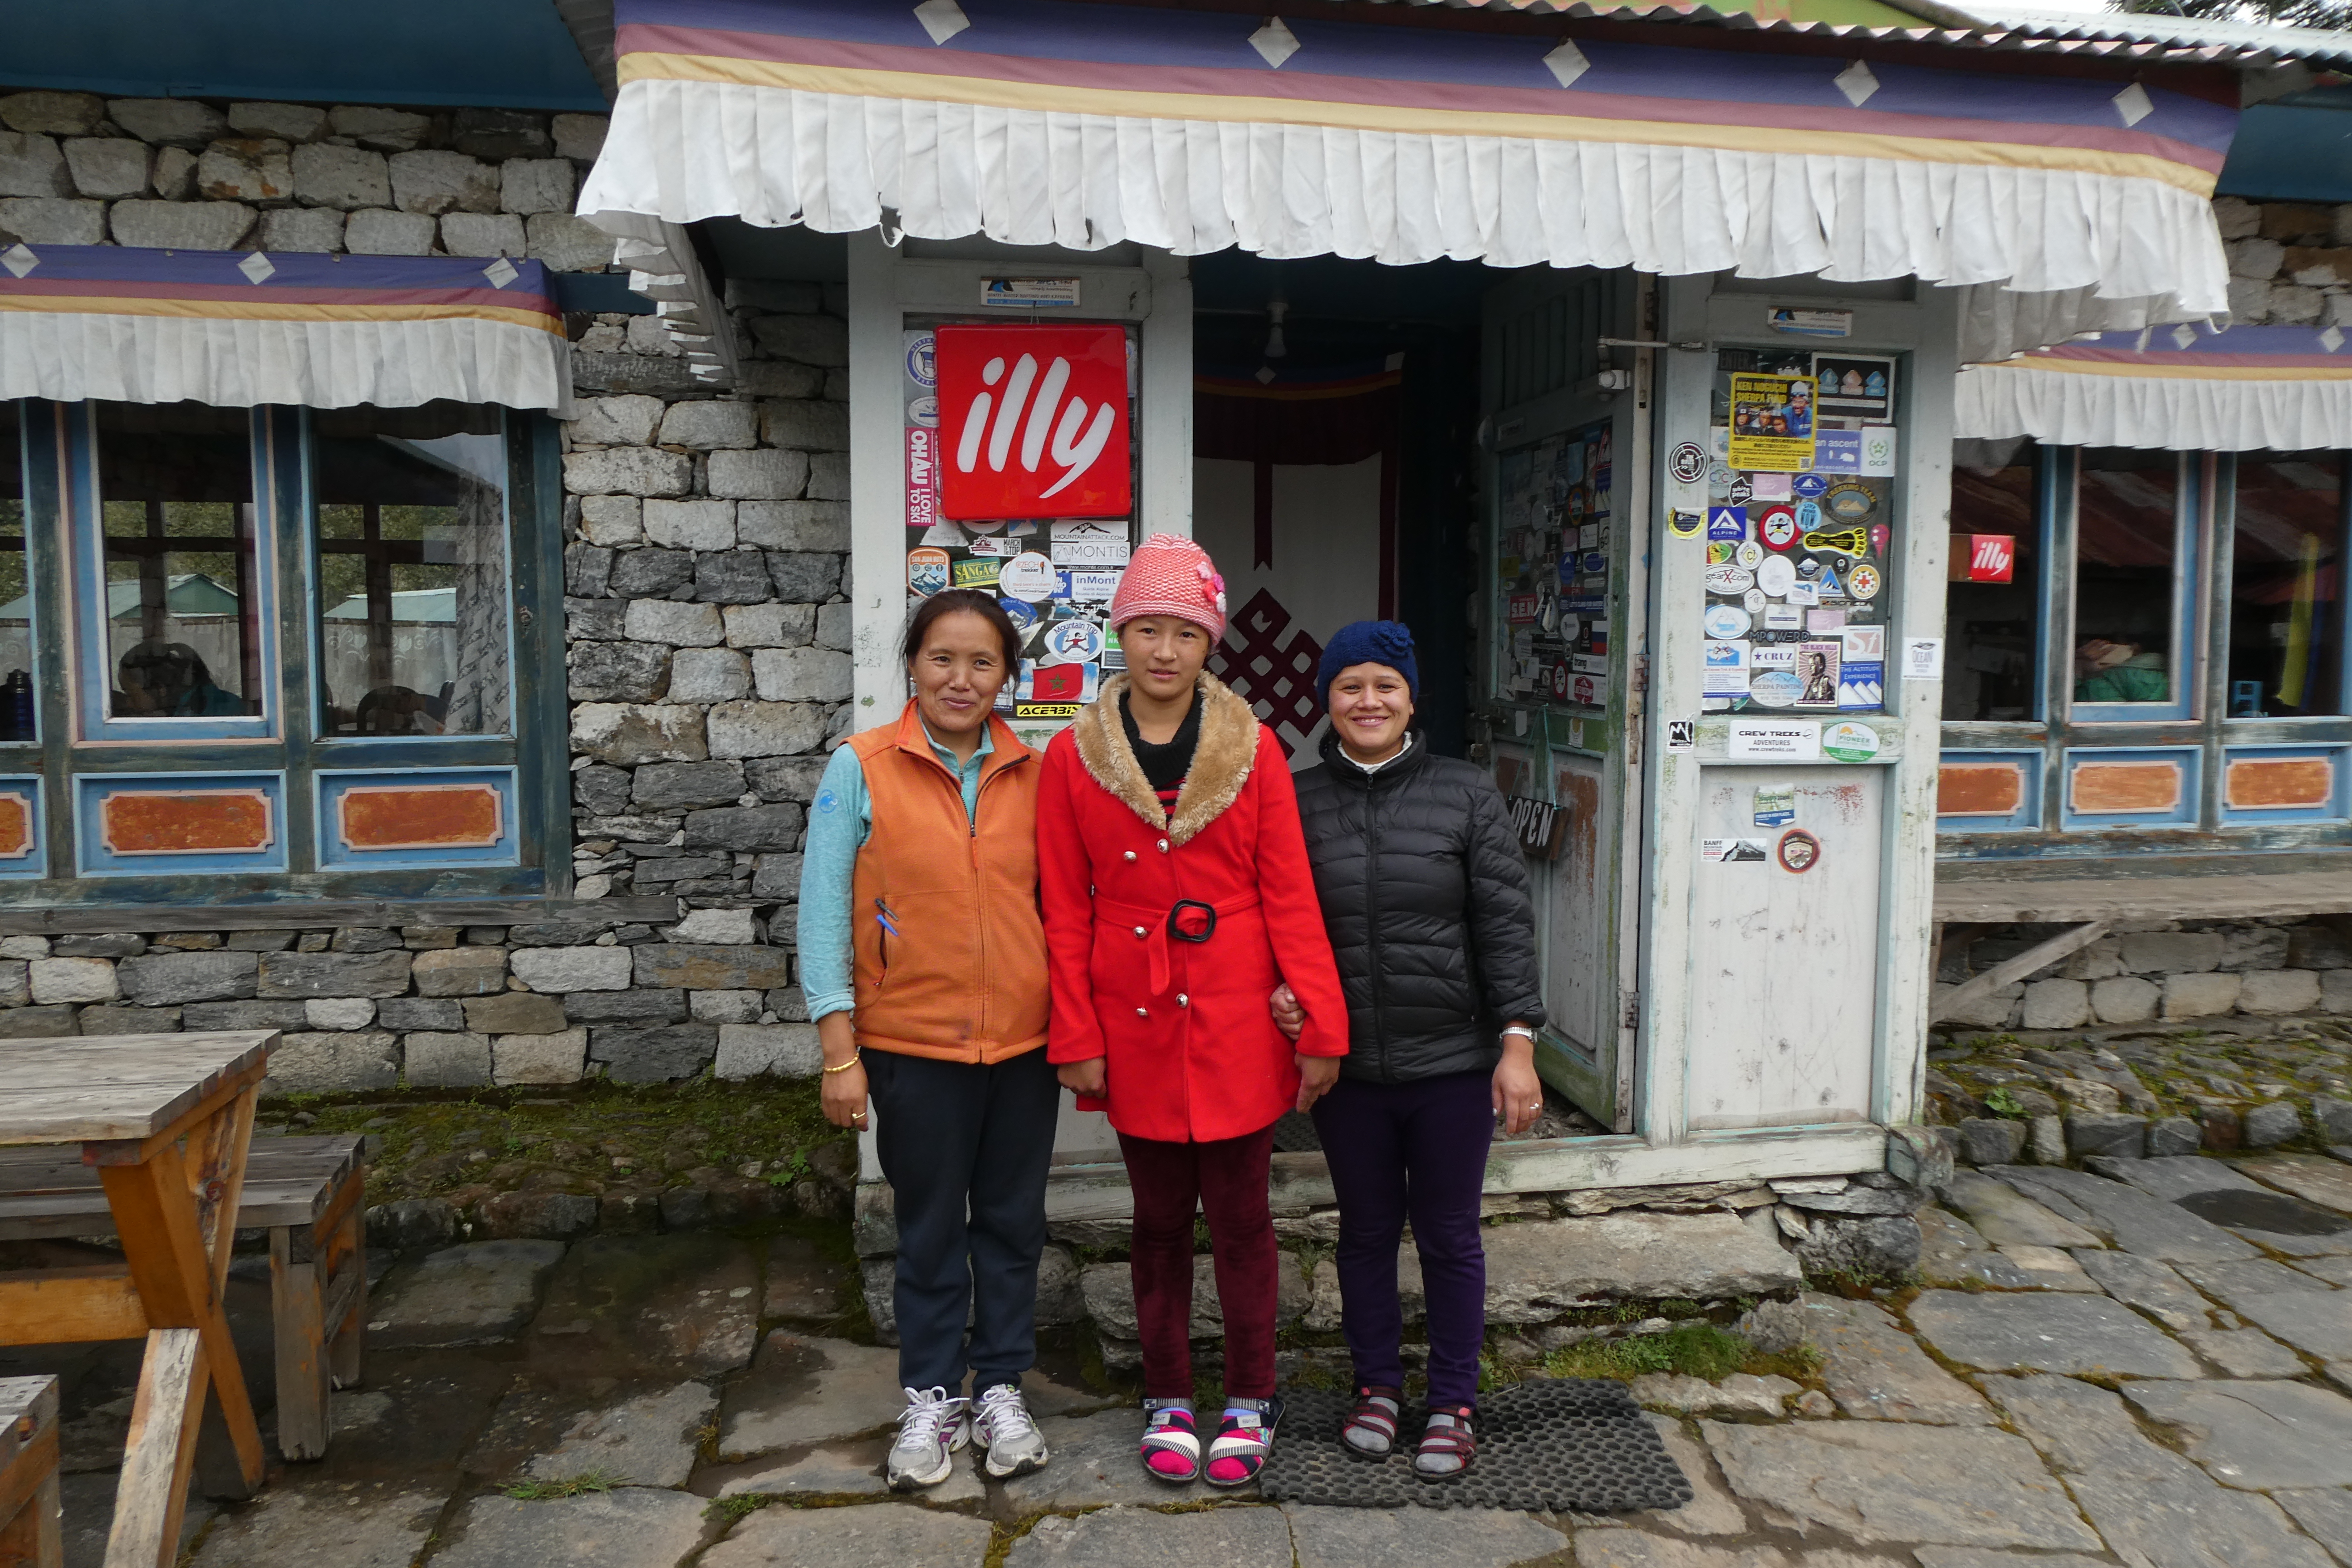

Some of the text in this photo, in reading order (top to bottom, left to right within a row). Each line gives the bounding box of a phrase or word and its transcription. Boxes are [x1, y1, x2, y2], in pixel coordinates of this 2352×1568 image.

[1737, 381, 1787, 392] KEN NOGUCHI
[1736, 392, 1765, 402] SHERPA
[957, 353, 1116, 499] illy
[1828, 439, 1859, 447] ascent
[911, 431, 933, 484] OHAU
[910, 488, 920, 523] TO SKI
[921, 495, 931, 523] LOVE
[1009, 546, 1020, 555] TOP
[1072, 546, 1127, 558] MONTIS
[1973, 541, 2010, 576] illy
[1077, 576, 1116, 584] inMont
[1054, 622, 1098, 635] Mountain Trip
[1749, 630, 1810, 642] MPOWERD
[1912, 650, 1933, 663] OCEAN
[1511, 797, 1554, 847] OPEN
